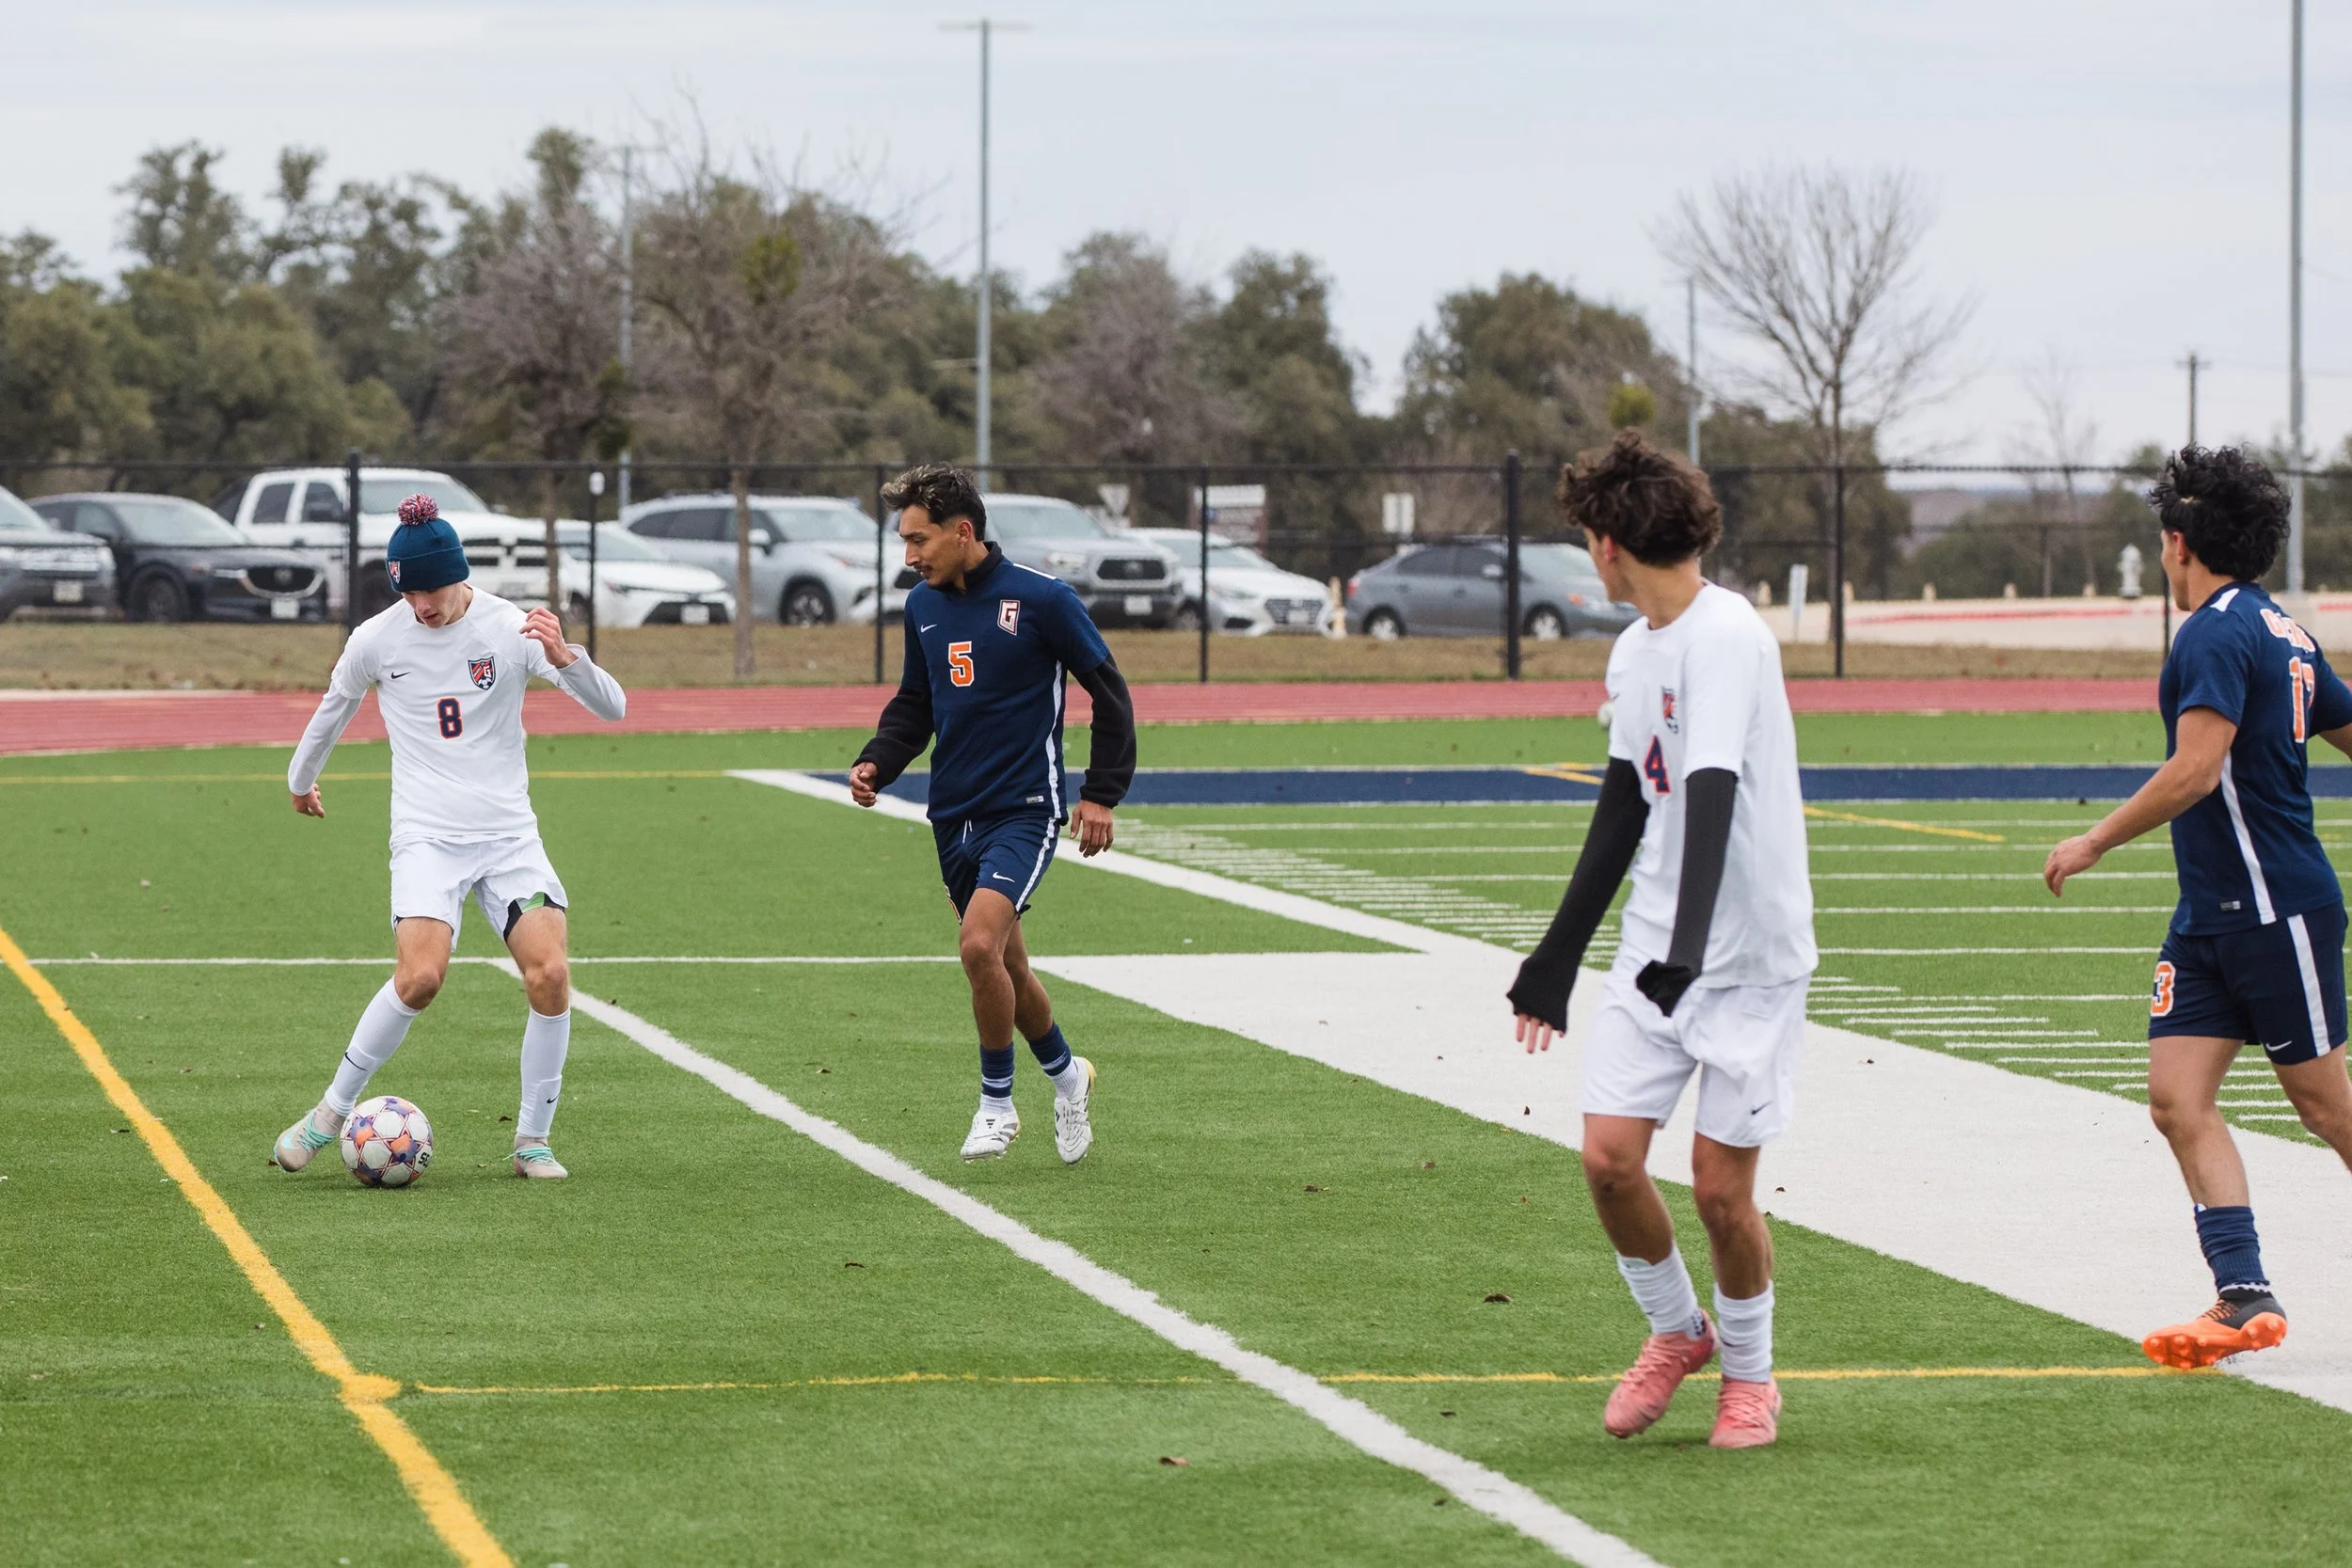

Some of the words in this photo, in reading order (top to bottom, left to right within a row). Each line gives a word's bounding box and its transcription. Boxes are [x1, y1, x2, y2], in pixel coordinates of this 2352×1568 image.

[997, 599, 1020, 636] G
[948, 641, 975, 687] 5
[437, 697, 463, 739] 8
[1644, 733, 1672, 794] 4
[2150, 960, 2176, 1017] 3
